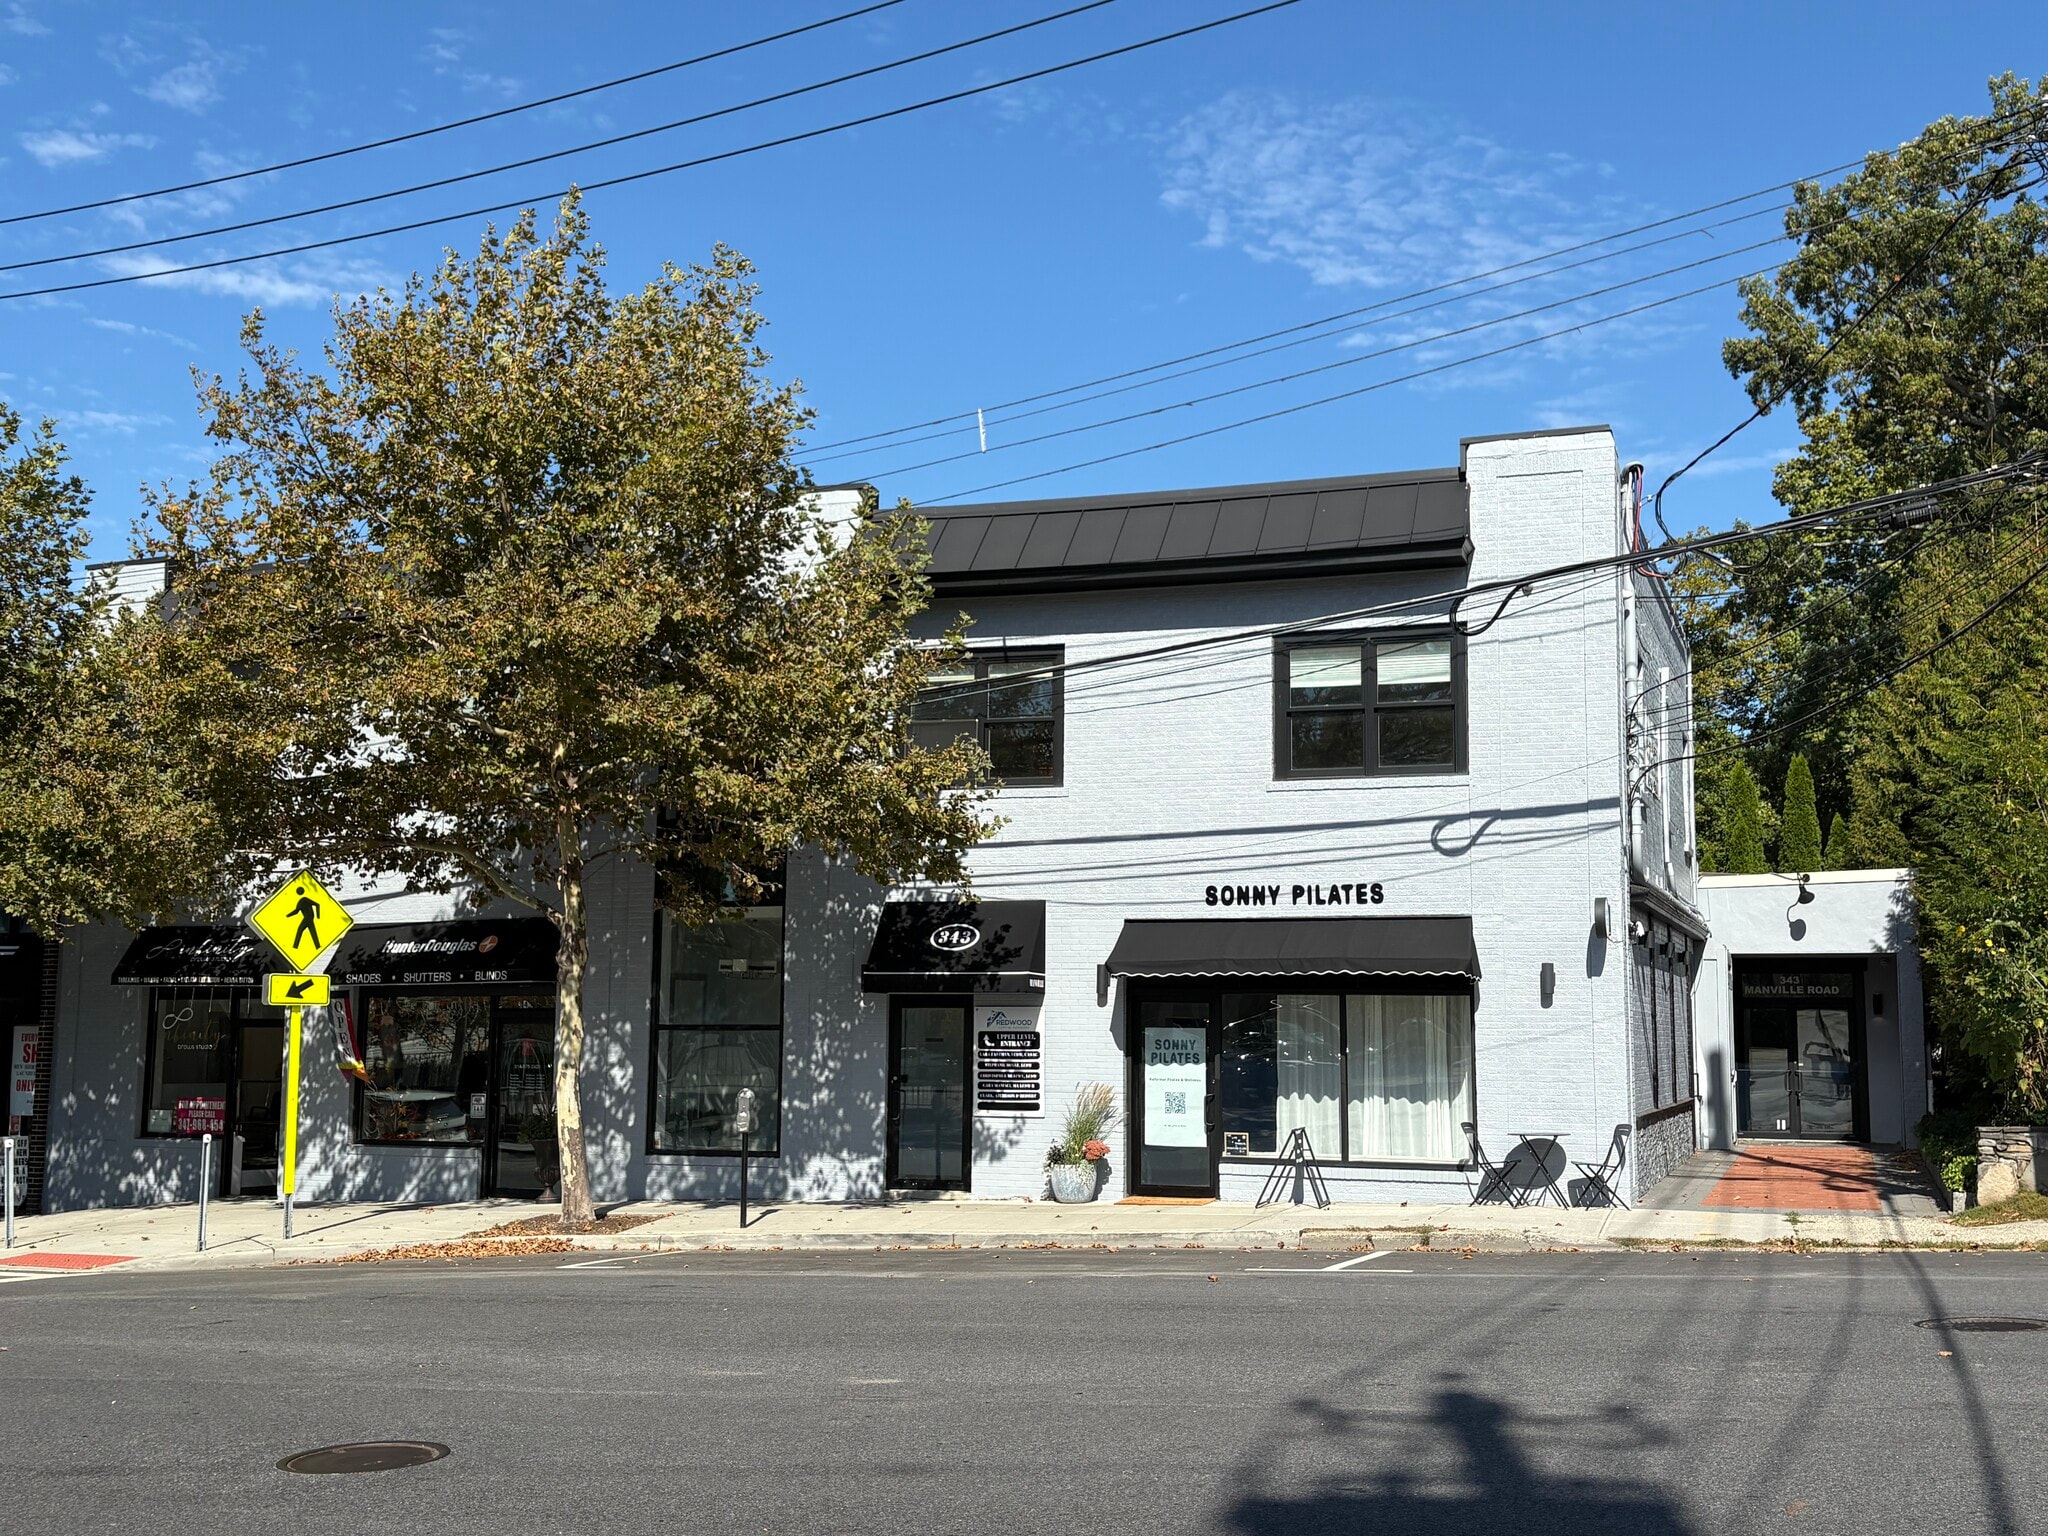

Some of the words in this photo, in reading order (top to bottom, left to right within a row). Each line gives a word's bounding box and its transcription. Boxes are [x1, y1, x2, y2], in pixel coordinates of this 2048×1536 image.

[1205, 885, 1280, 906] SONNY
[1292, 883, 1384, 905] PILATES
[938, 930, 972, 944] 343
[345, 973, 382, 983] SHADES
[403, 972, 452, 982] SHUTTERS
[474, 971, 508, 981] BLINDS
[1780, 976, 1800, 984] 343
[1744, 986, 1804, 994] MANVILLE
[1807, 986, 1840, 994] ROAD
[334, 1000, 353, 1060] OPEN
[1155, 1039, 1196, 1050] SONNY
[1151, 1052, 1200, 1064] PILATES
[189, 1100, 226, 1110] APPOINTMEN
[188, 1110, 204, 1118] PLEASE
[205, 1110, 216, 1118] CALL
[178, 1118, 225, 1131] 347-968-454
